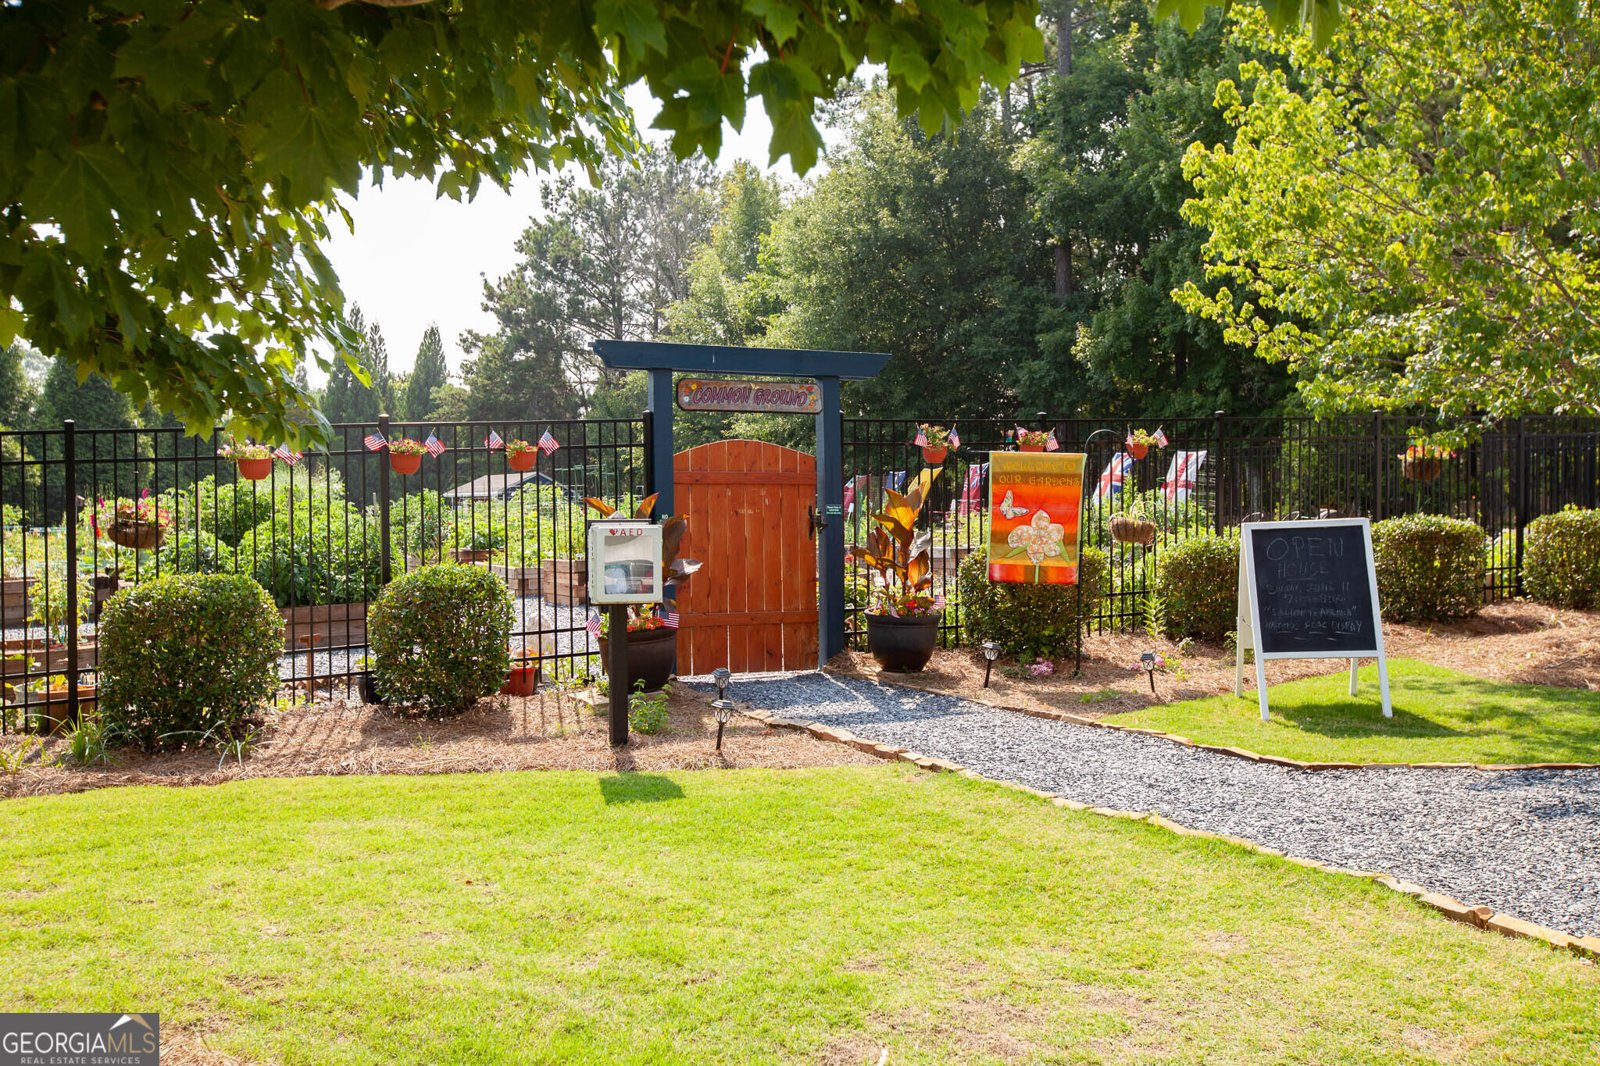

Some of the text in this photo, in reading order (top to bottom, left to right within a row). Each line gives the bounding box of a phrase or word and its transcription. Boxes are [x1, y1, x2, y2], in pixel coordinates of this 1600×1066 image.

[692, 386, 808, 407] COMMON GROUND
[999, 474, 1081, 487] OUR GARDENS
[620, 528, 643, 536] AED
[1266, 536, 1344, 560] OPEN
[1277, 560, 1329, 578] HOUSE
